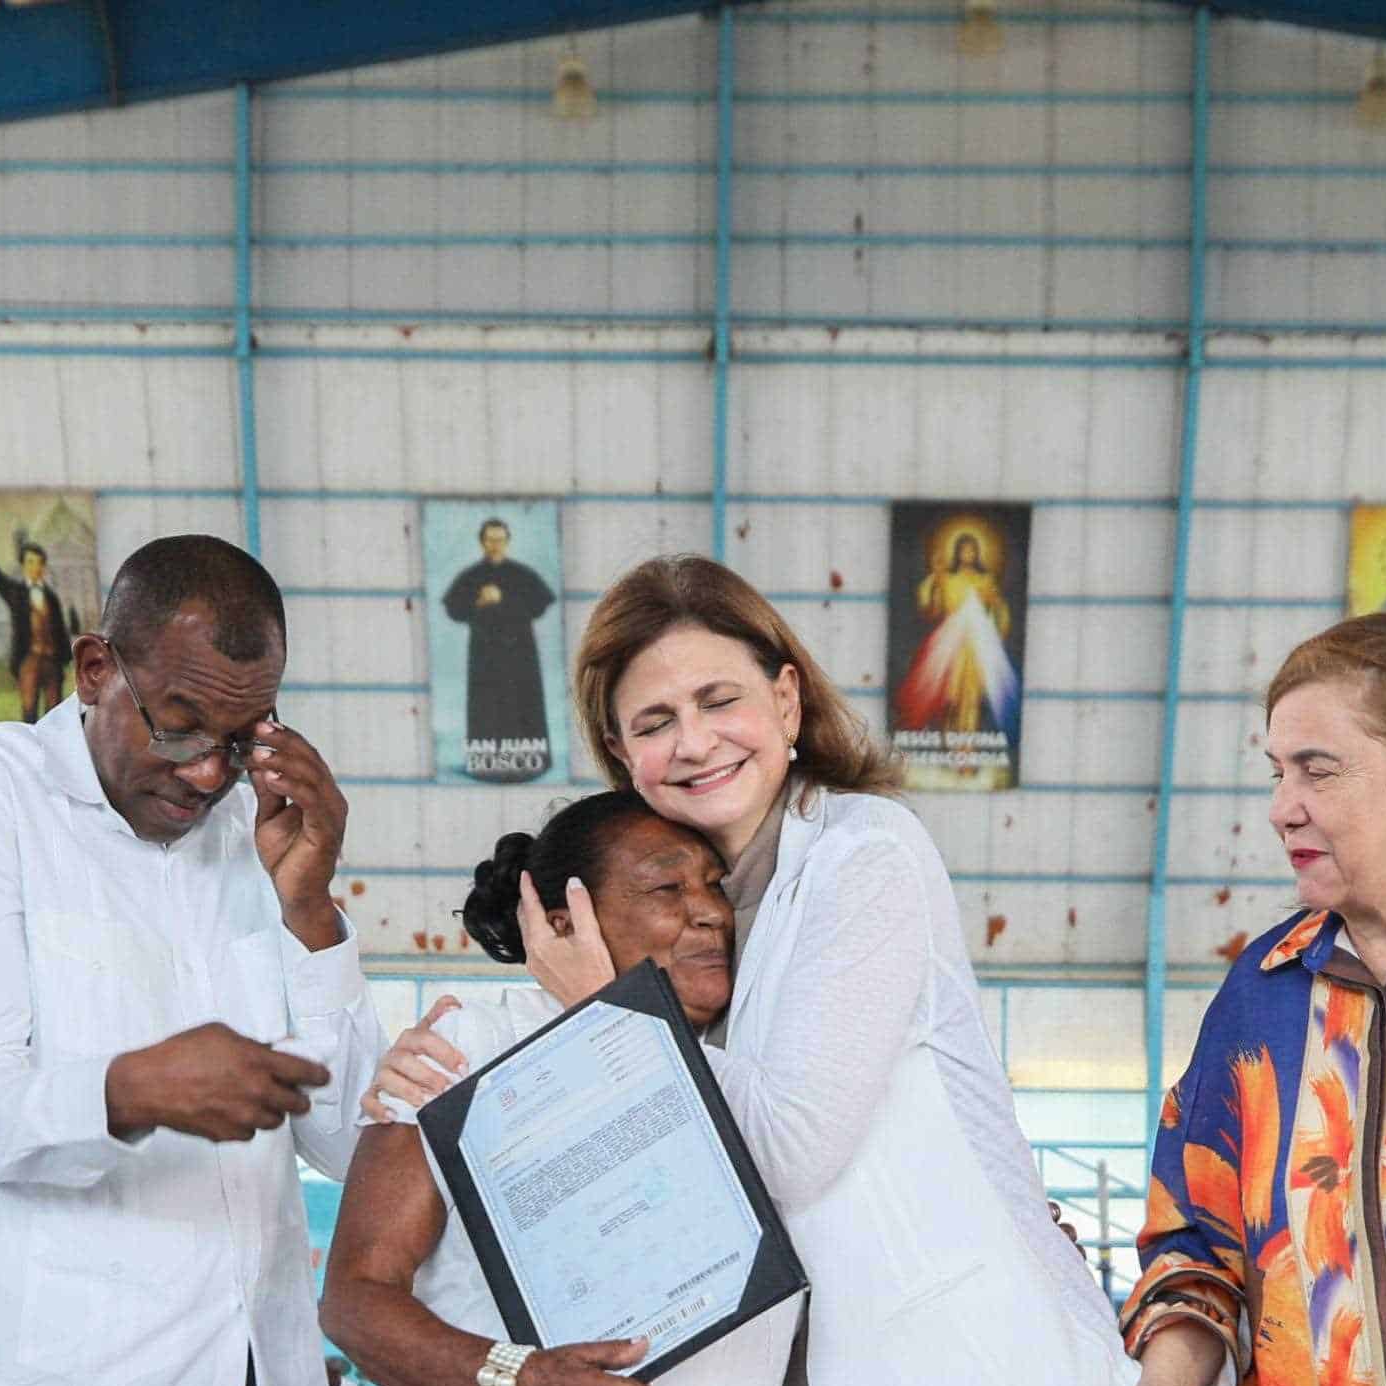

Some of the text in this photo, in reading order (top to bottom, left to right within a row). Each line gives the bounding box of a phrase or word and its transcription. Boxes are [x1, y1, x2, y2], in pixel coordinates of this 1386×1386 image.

[500, 738, 548, 753] JUAN
[945, 731, 1008, 747] DIVINA
[468, 752, 544, 770] BOSCO
